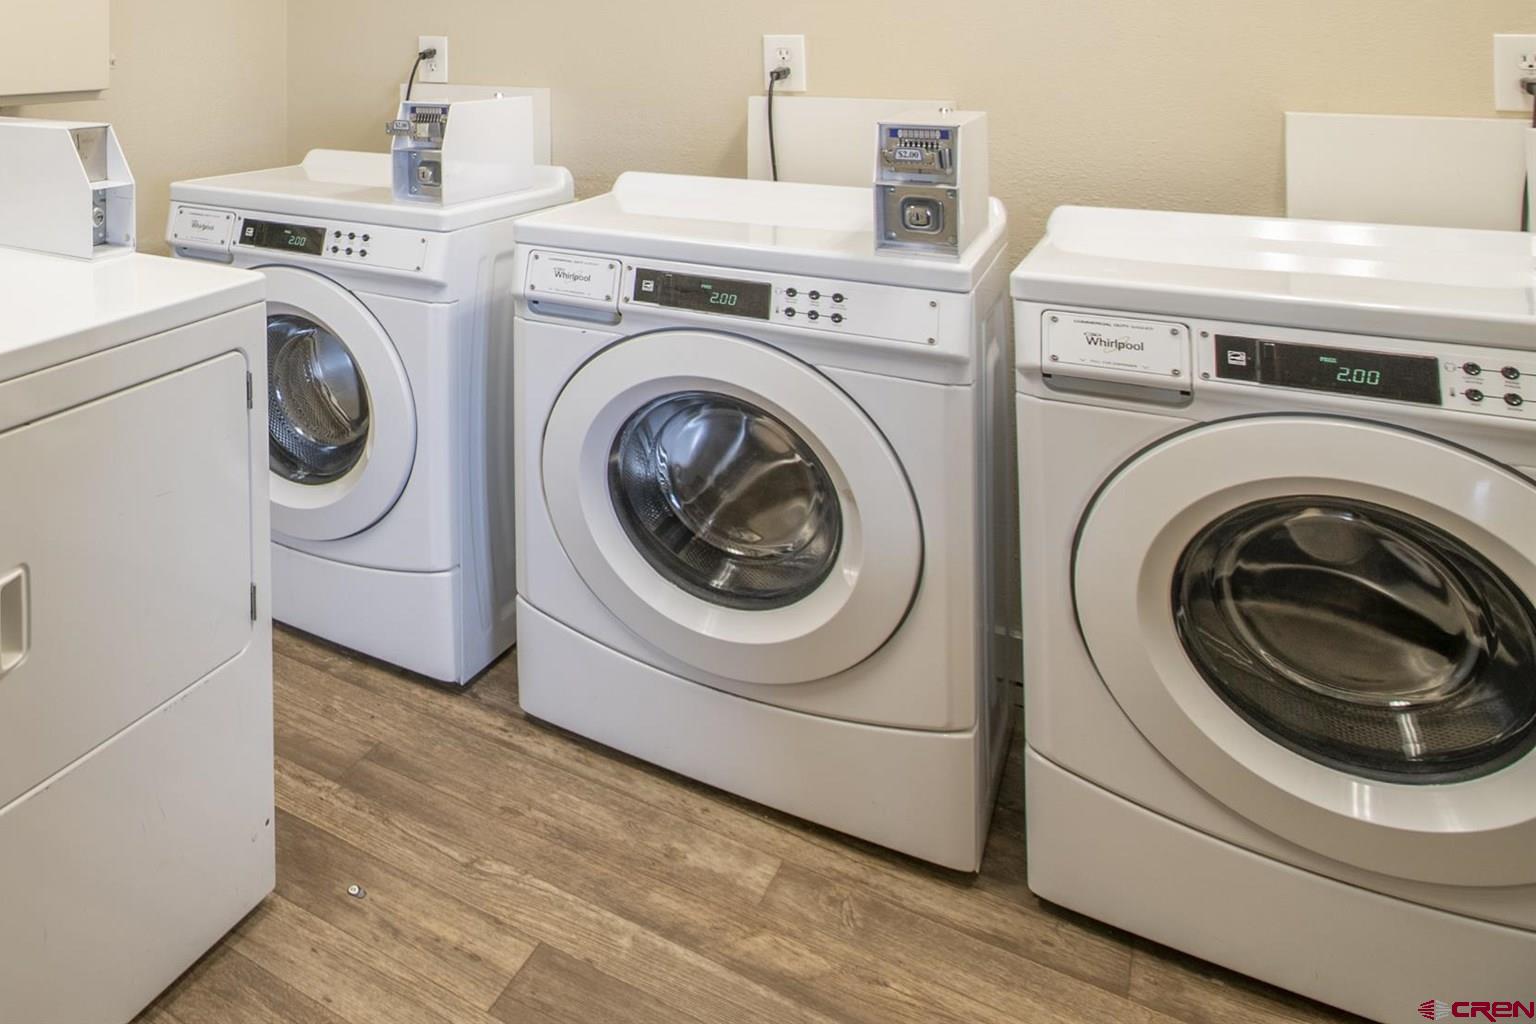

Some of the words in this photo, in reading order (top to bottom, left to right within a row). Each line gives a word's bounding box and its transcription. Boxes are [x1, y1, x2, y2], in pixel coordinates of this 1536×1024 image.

[554, 271, 591, 282] Whirlpool
[710, 292, 738, 307] 2.00
[1085, 335, 1144, 351] Whirlpool
[1336, 366, 1381, 386] 2.00
